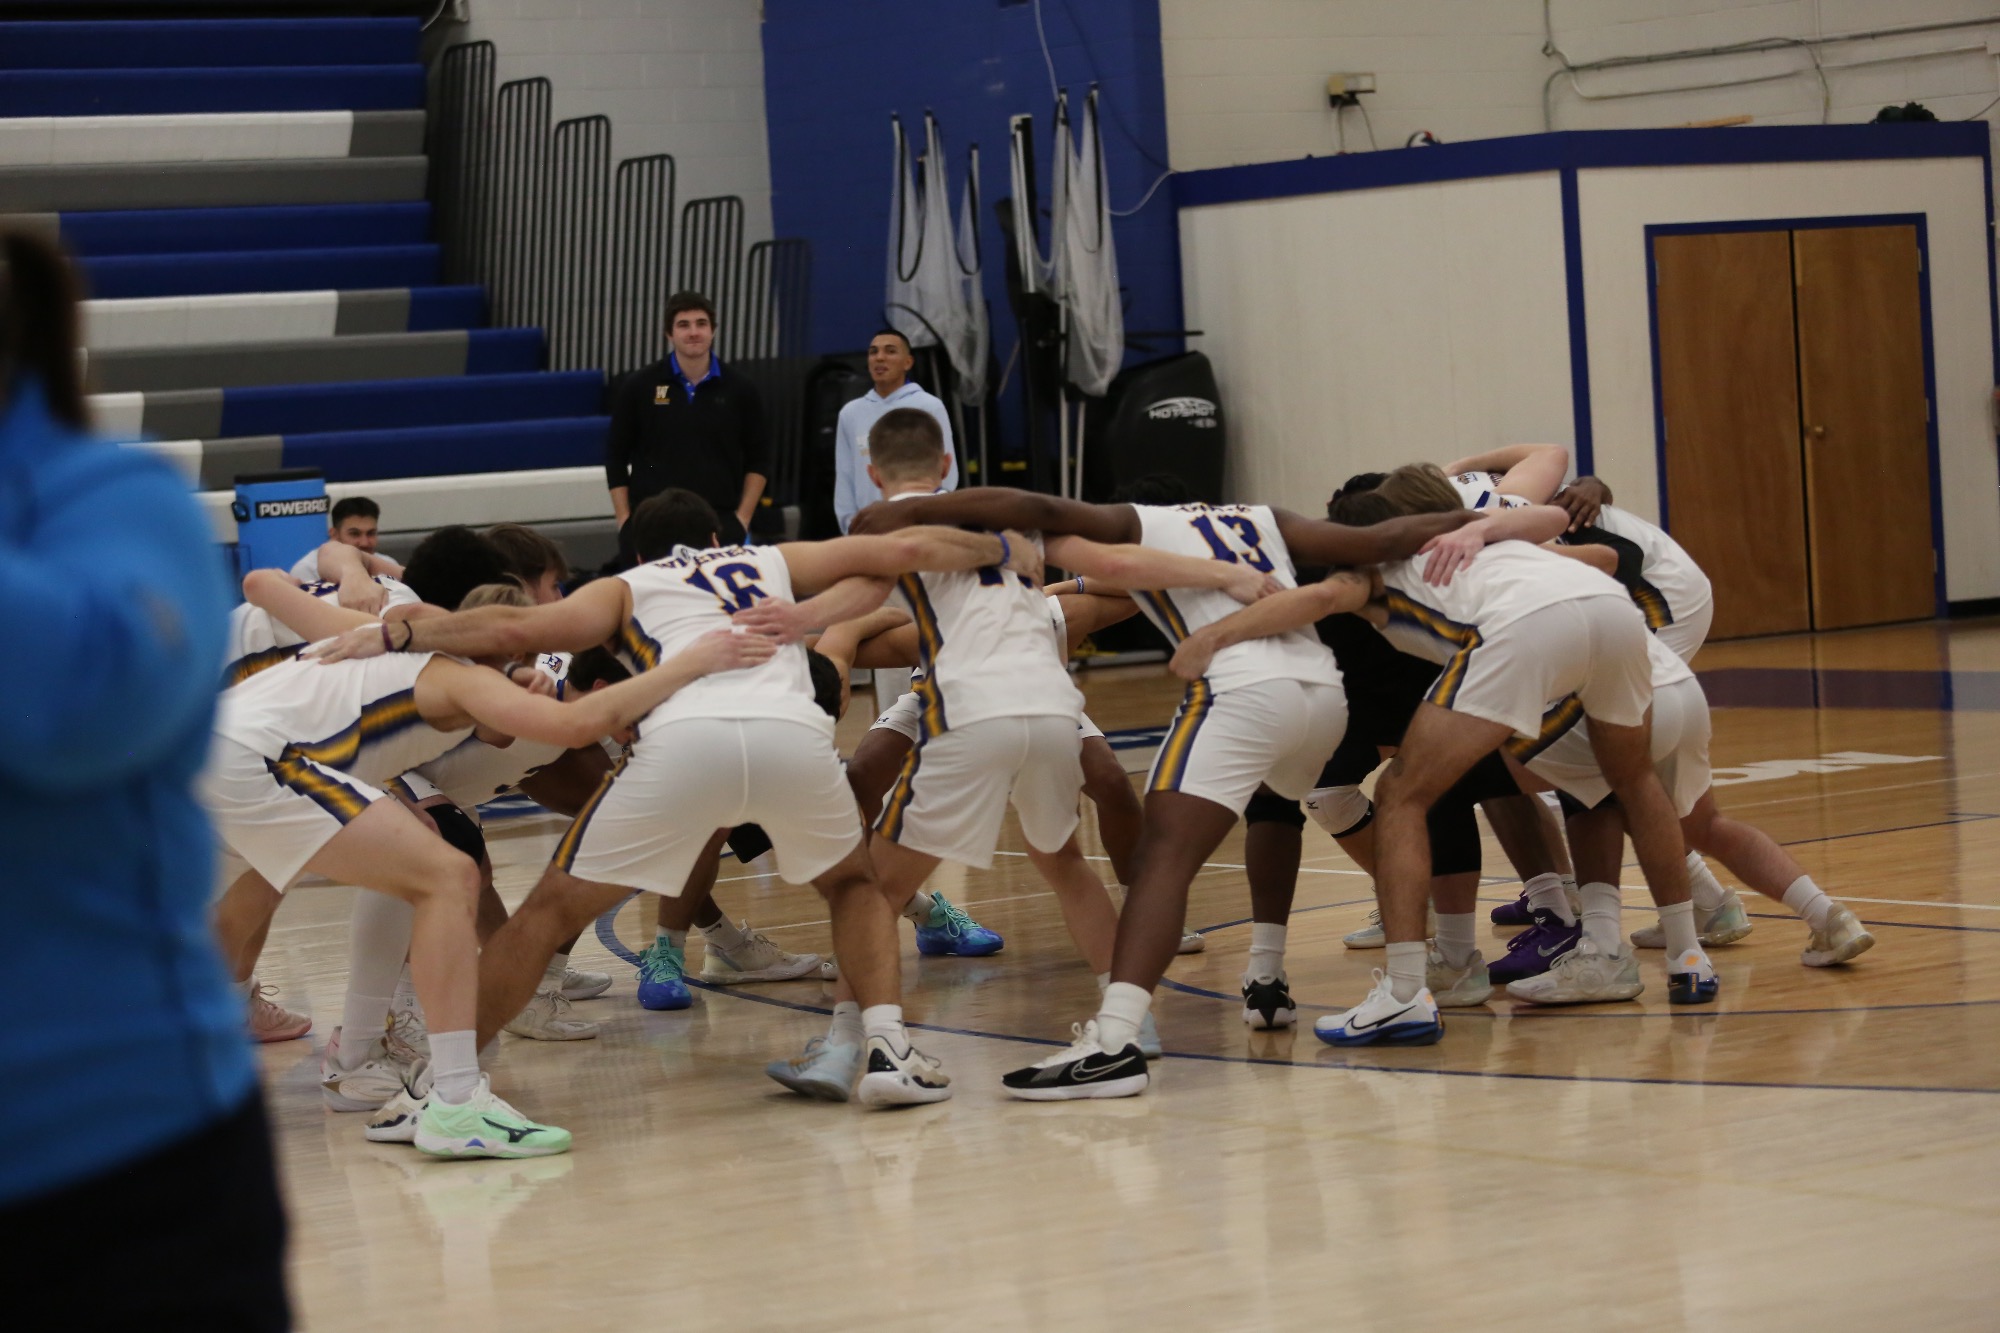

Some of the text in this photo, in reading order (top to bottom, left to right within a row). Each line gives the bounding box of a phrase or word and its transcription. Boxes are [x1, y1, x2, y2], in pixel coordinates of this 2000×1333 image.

[259, 499, 328, 517] POWERADE
[1189, 514, 1276, 574] 13
[683, 561, 770, 615] 16
